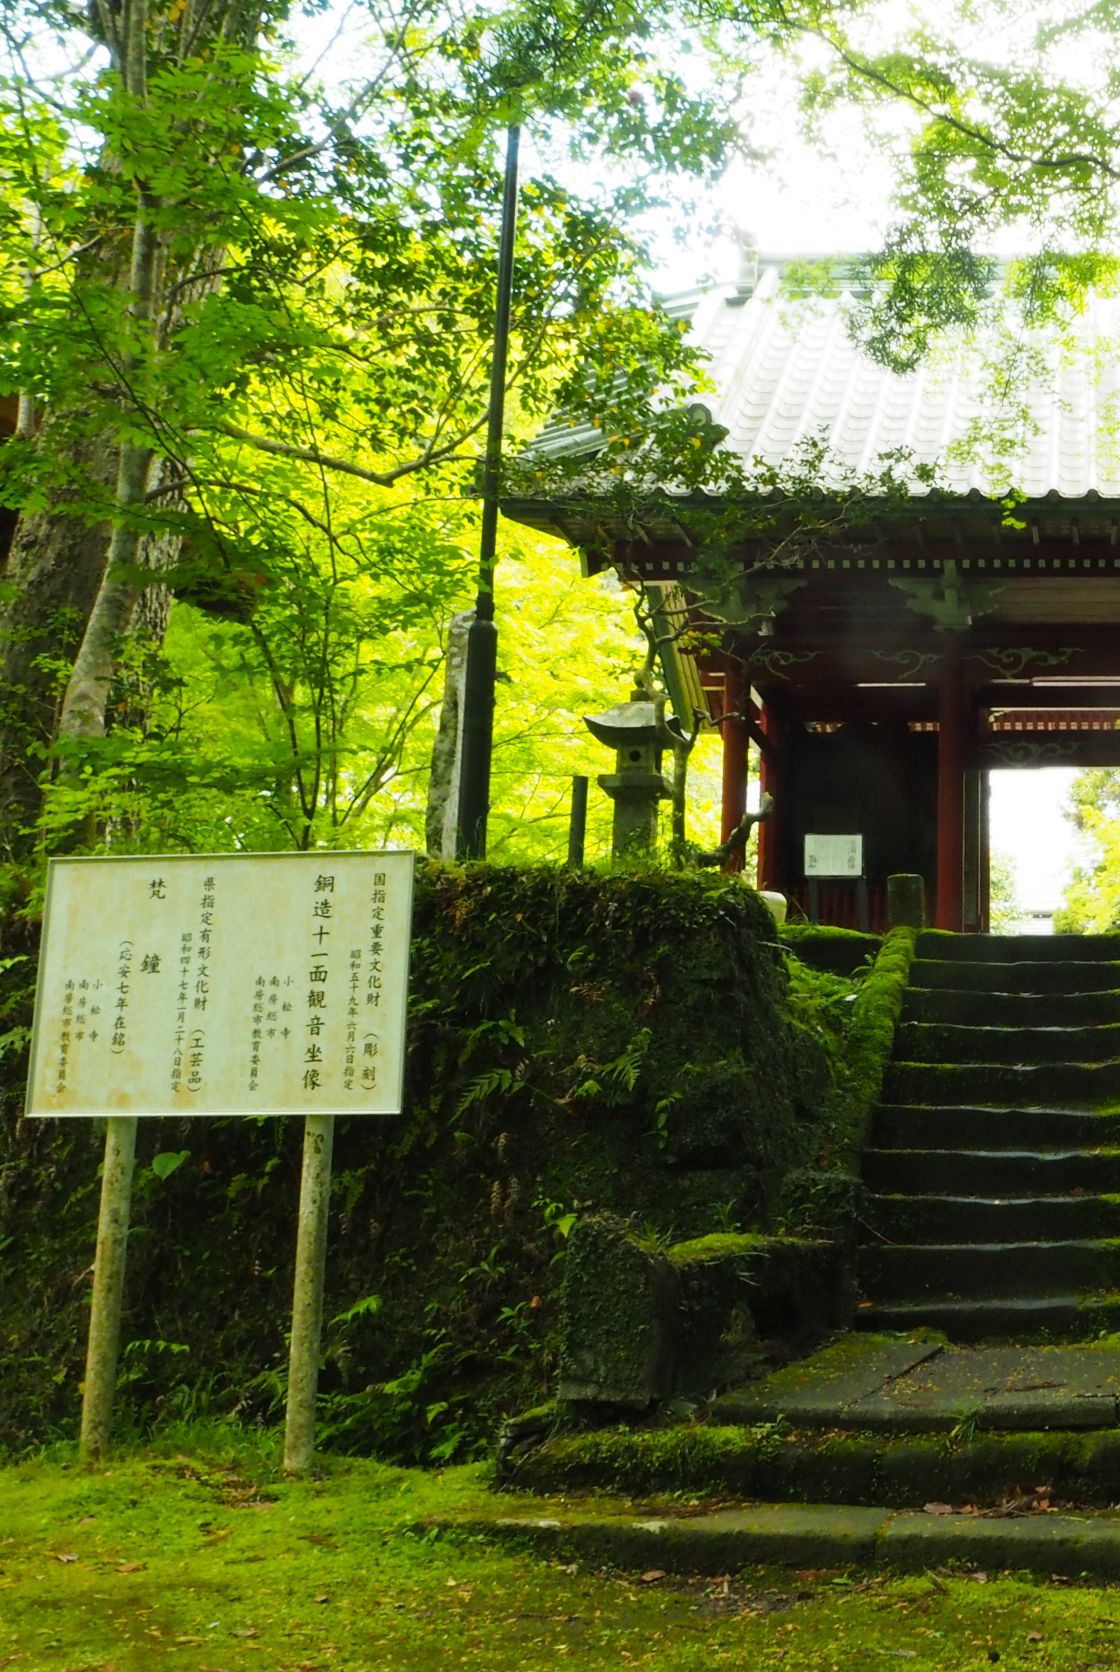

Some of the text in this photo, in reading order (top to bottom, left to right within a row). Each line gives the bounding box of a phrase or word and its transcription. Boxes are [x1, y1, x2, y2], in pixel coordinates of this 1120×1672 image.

[193, 877, 215, 1012] 県指定有形文化財
[266, 975, 280, 1039] 南房総市
[280, 975, 294, 1039] 小松寺
[302, 874, 335, 1090] 銅造十一面観音坐像
[366, 872, 387, 1007] 国指定重要文化財
[89, 979, 103, 1042] 小松寺
[170, 933, 192, 1093] 昭和四十七年一月二十八日指定
[248, 976, 266, 1092] 南房総市教育委員会
[343, 949, 362, 1090] 昭和五十九年六月六日指定
